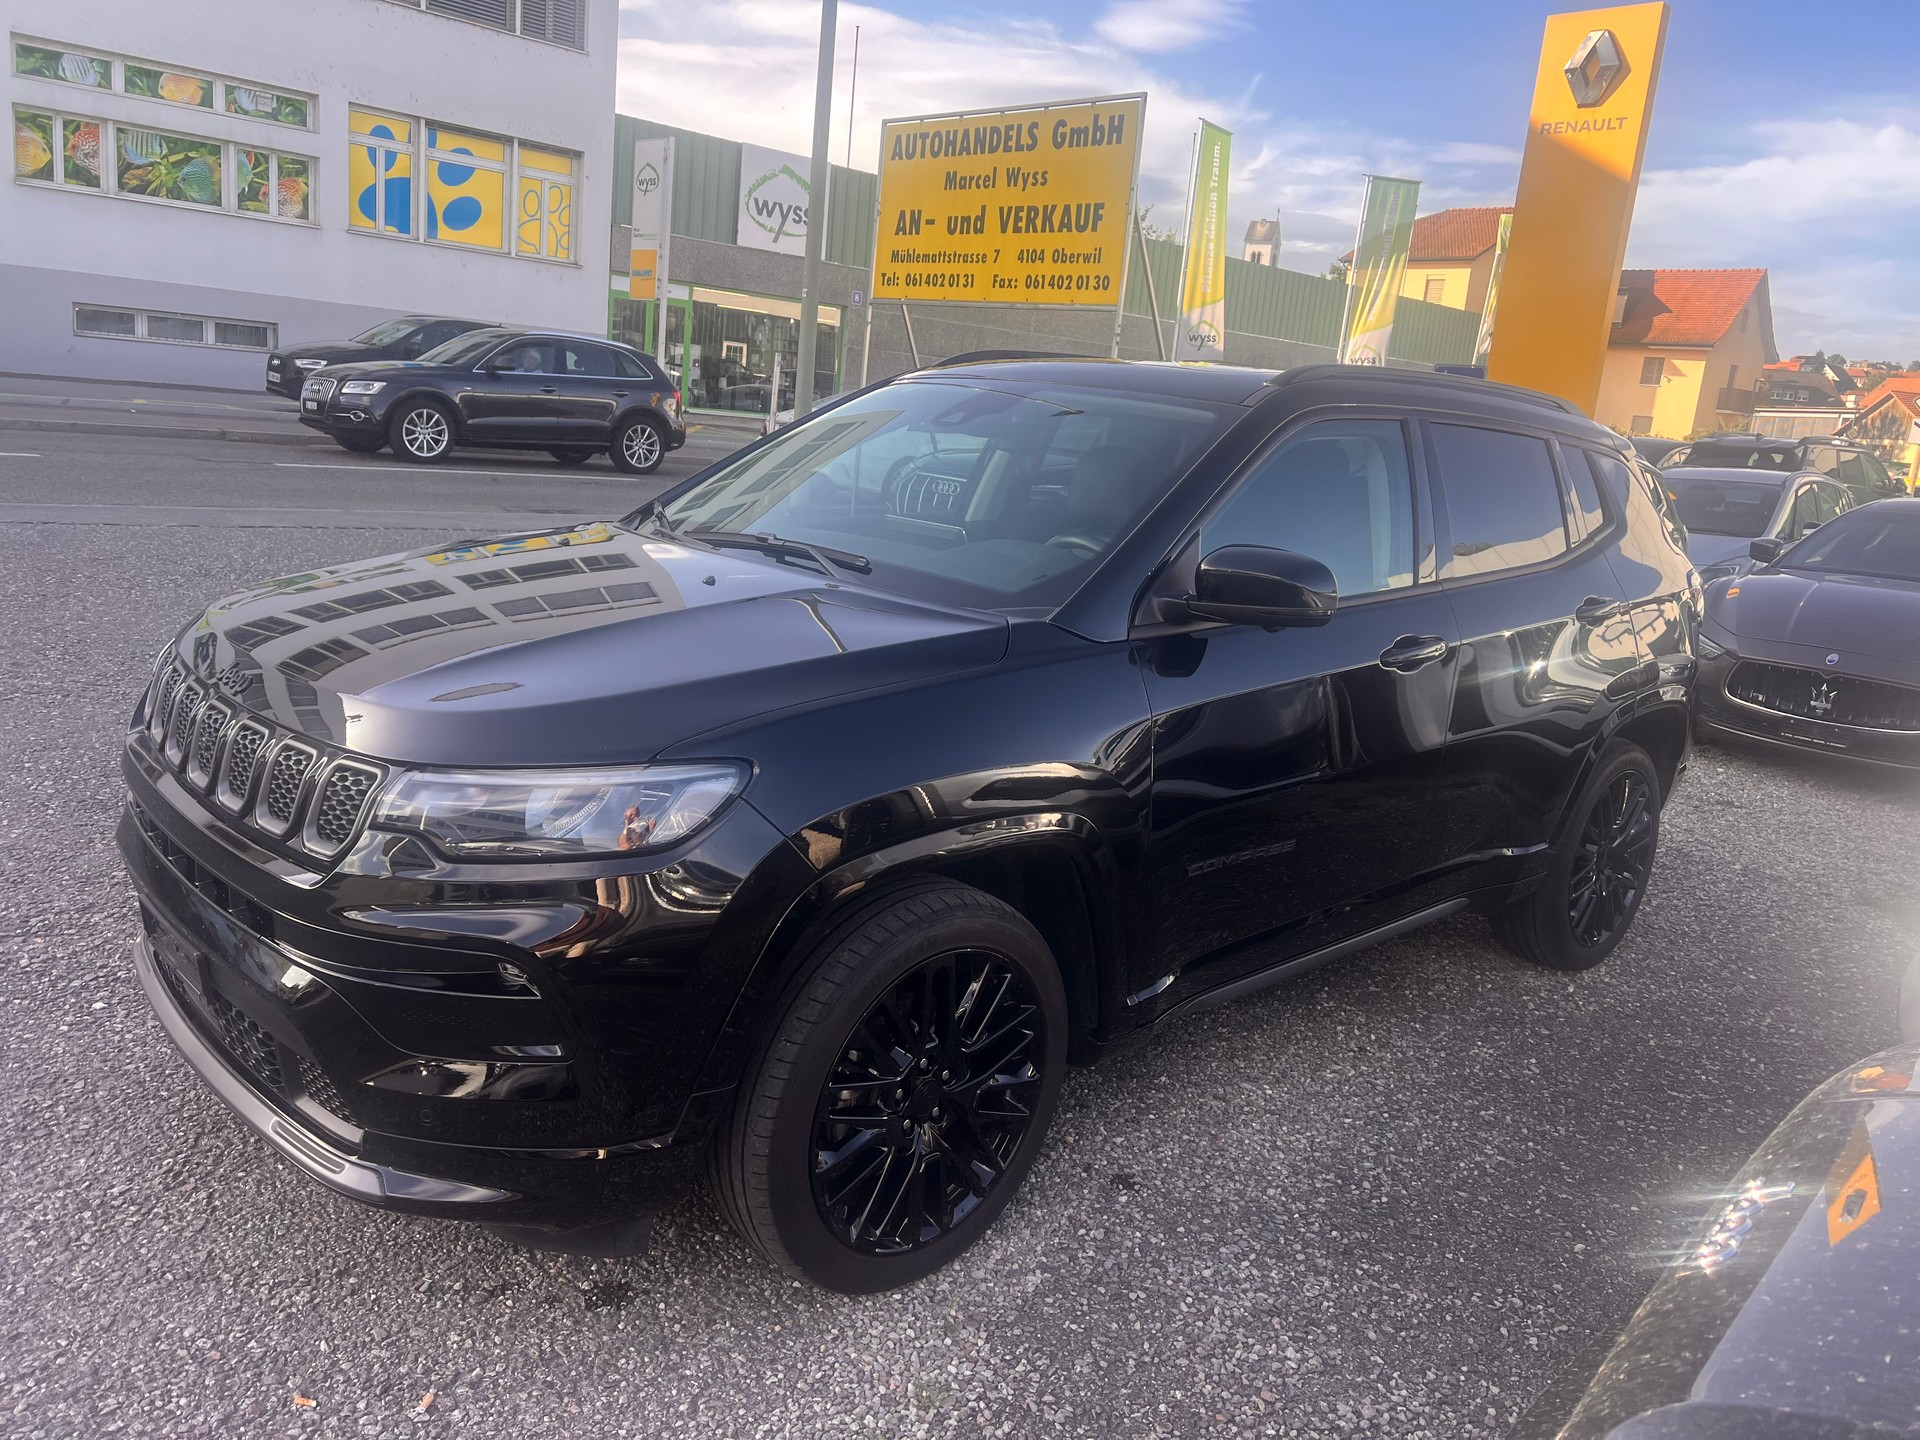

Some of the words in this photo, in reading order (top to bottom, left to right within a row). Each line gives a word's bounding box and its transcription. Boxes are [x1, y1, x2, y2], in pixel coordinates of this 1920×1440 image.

[890, 121, 1040, 161] AUTOHANDELS
[1052, 113, 1125, 150] GmbH
[1539, 116, 1629, 135] RENAULT
[638, 177, 656, 197] wyss
[943, 166, 998, 191] Marcel
[1005, 166, 1049, 192] Wyss
[894, 209, 936, 236] AN-
[946, 204, 987, 236] und
[998, 202, 1105, 234] VERKAUF
[1206, 192, 1219, 241] deinen
[890, 248, 987, 264] Mühlemattstrasse
[992, 248, 1001, 264] 7
[1017, 248, 1045, 264] 4104
[1051, 247, 1102, 264] Oberwil
[881, 272, 900, 287] Tel:
[992, 274, 1018, 289] Fax:
[1188, 332, 1217, 351] wyss
[215, 660, 254, 698] Jeep
